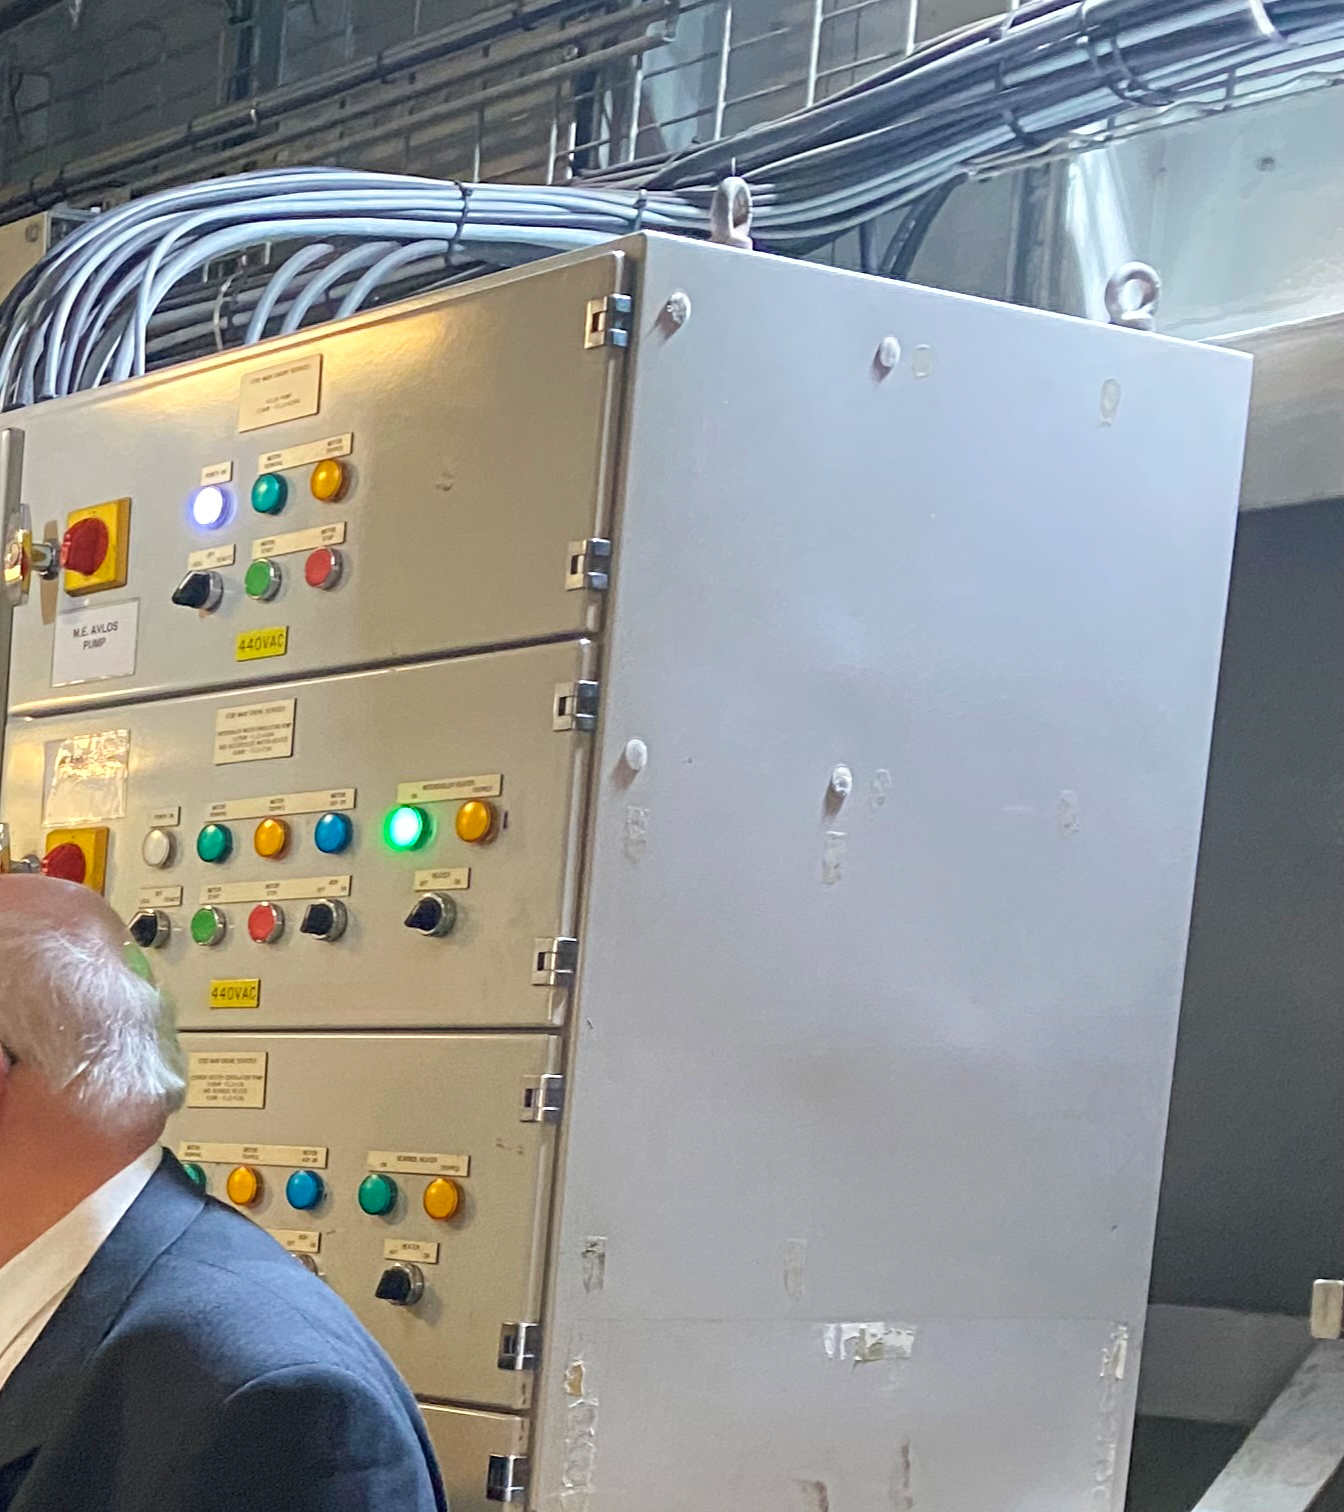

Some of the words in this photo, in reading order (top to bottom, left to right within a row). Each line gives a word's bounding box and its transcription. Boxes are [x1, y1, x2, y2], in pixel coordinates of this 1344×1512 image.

[73, 627, 89, 639] M.E.
[90, 621, 119, 635] AVLOS
[83, 637, 106, 650] PUMP
[238, 633, 284, 651] 440VAC
[211, 985, 258, 1001] 440VAC
